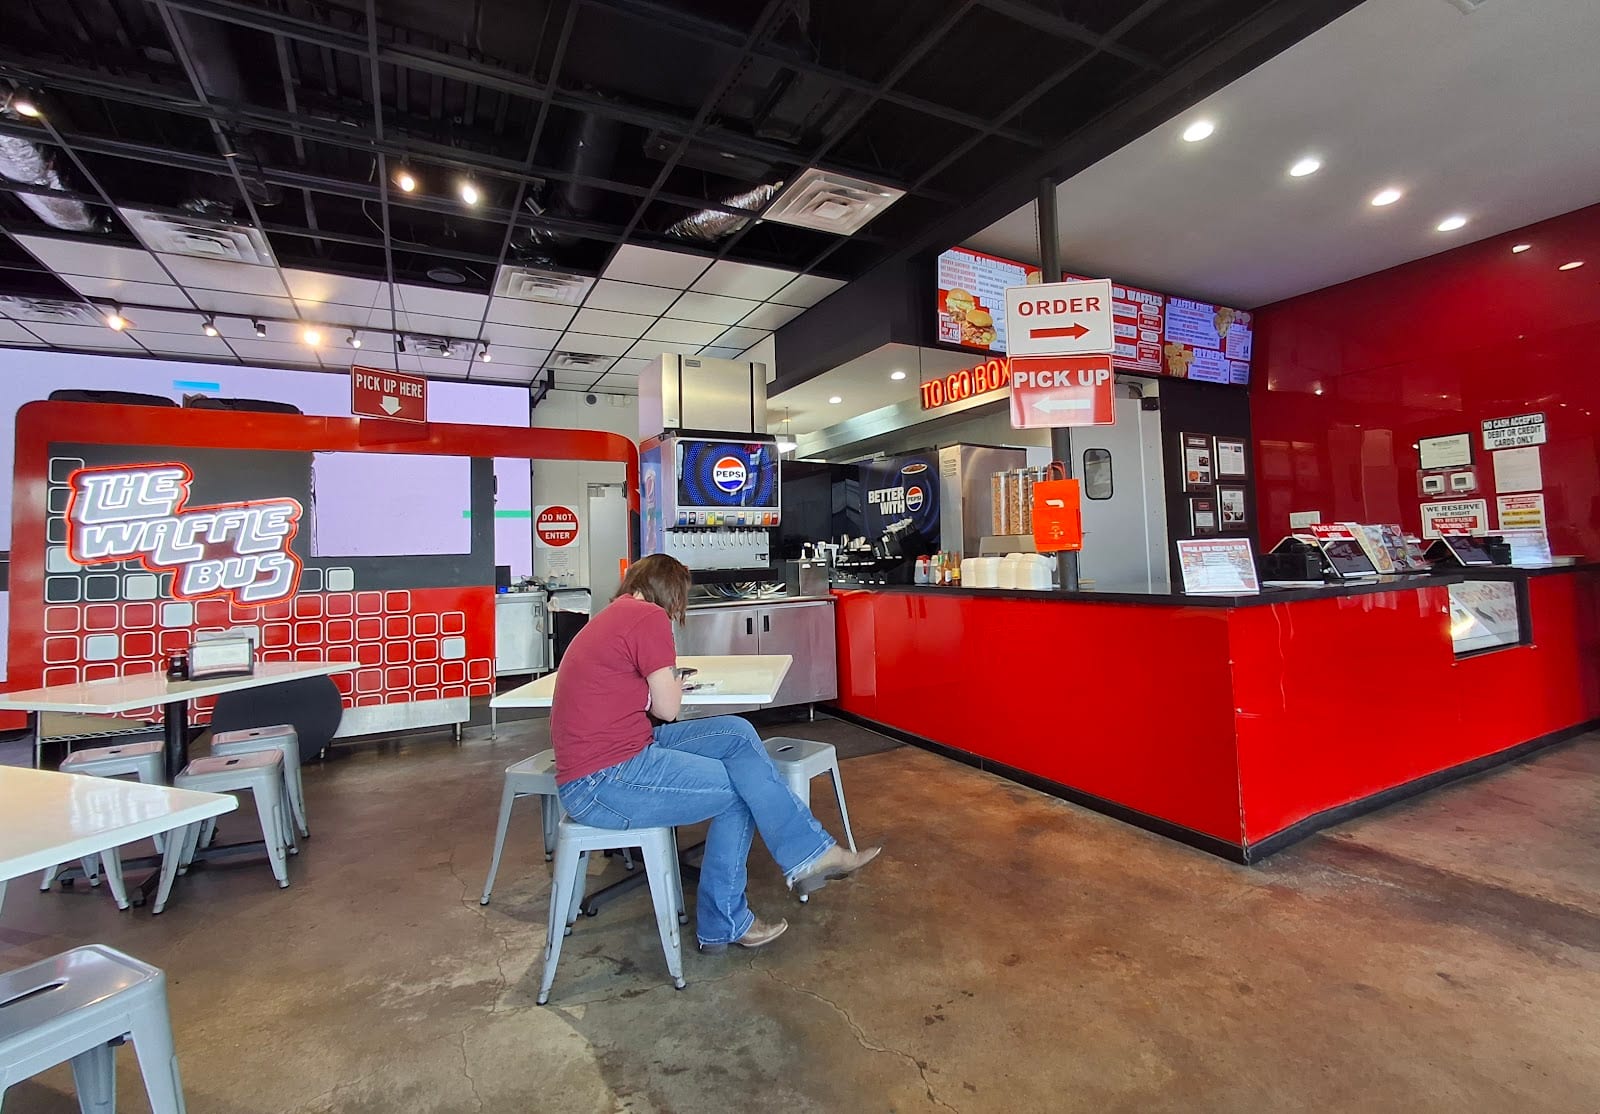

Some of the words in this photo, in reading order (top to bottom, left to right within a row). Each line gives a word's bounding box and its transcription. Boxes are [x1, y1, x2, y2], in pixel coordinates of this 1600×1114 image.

[1018, 297, 1101, 316] ORDER
[1127, 290, 1163, 307] WAFFLES
[356, 373, 380, 391] PICK
[383, 378, 397, 393] UP
[399, 381, 423, 398] HERE
[920, 380, 943, 409] TO
[946, 370, 971, 402] GO
[974, 358, 1010, 394] BOX
[1013, 370, 1071, 388] PICK
[1078, 369, 1110, 386] UP
[1483, 421, 1492, 429] NO
[1493, 418, 1510, 428] CASH
[1511, 414, 1543, 426] ACCEPTED
[1488, 429, 1505, 439] DEBIT
[1507, 428, 1517, 436] OR
[1518, 425, 1541, 435] CREDIT
[1494, 438, 1515, 447] CARDS
[1516, 435, 1534, 444] ONLY
[716, 470, 744, 478] PEPSI
[80, 470, 186, 525] THE
[868, 487, 905, 504] BETTER
[880, 500, 905, 515] WITH
[1426, 504, 1439, 512] WE
[1441, 503, 1481, 511] RESERVE
[556, 513, 573, 521] NOT
[81, 504, 295, 567] WAFFLE
[545, 532, 570, 540] ENTER
[182, 552, 295, 603] BUS
